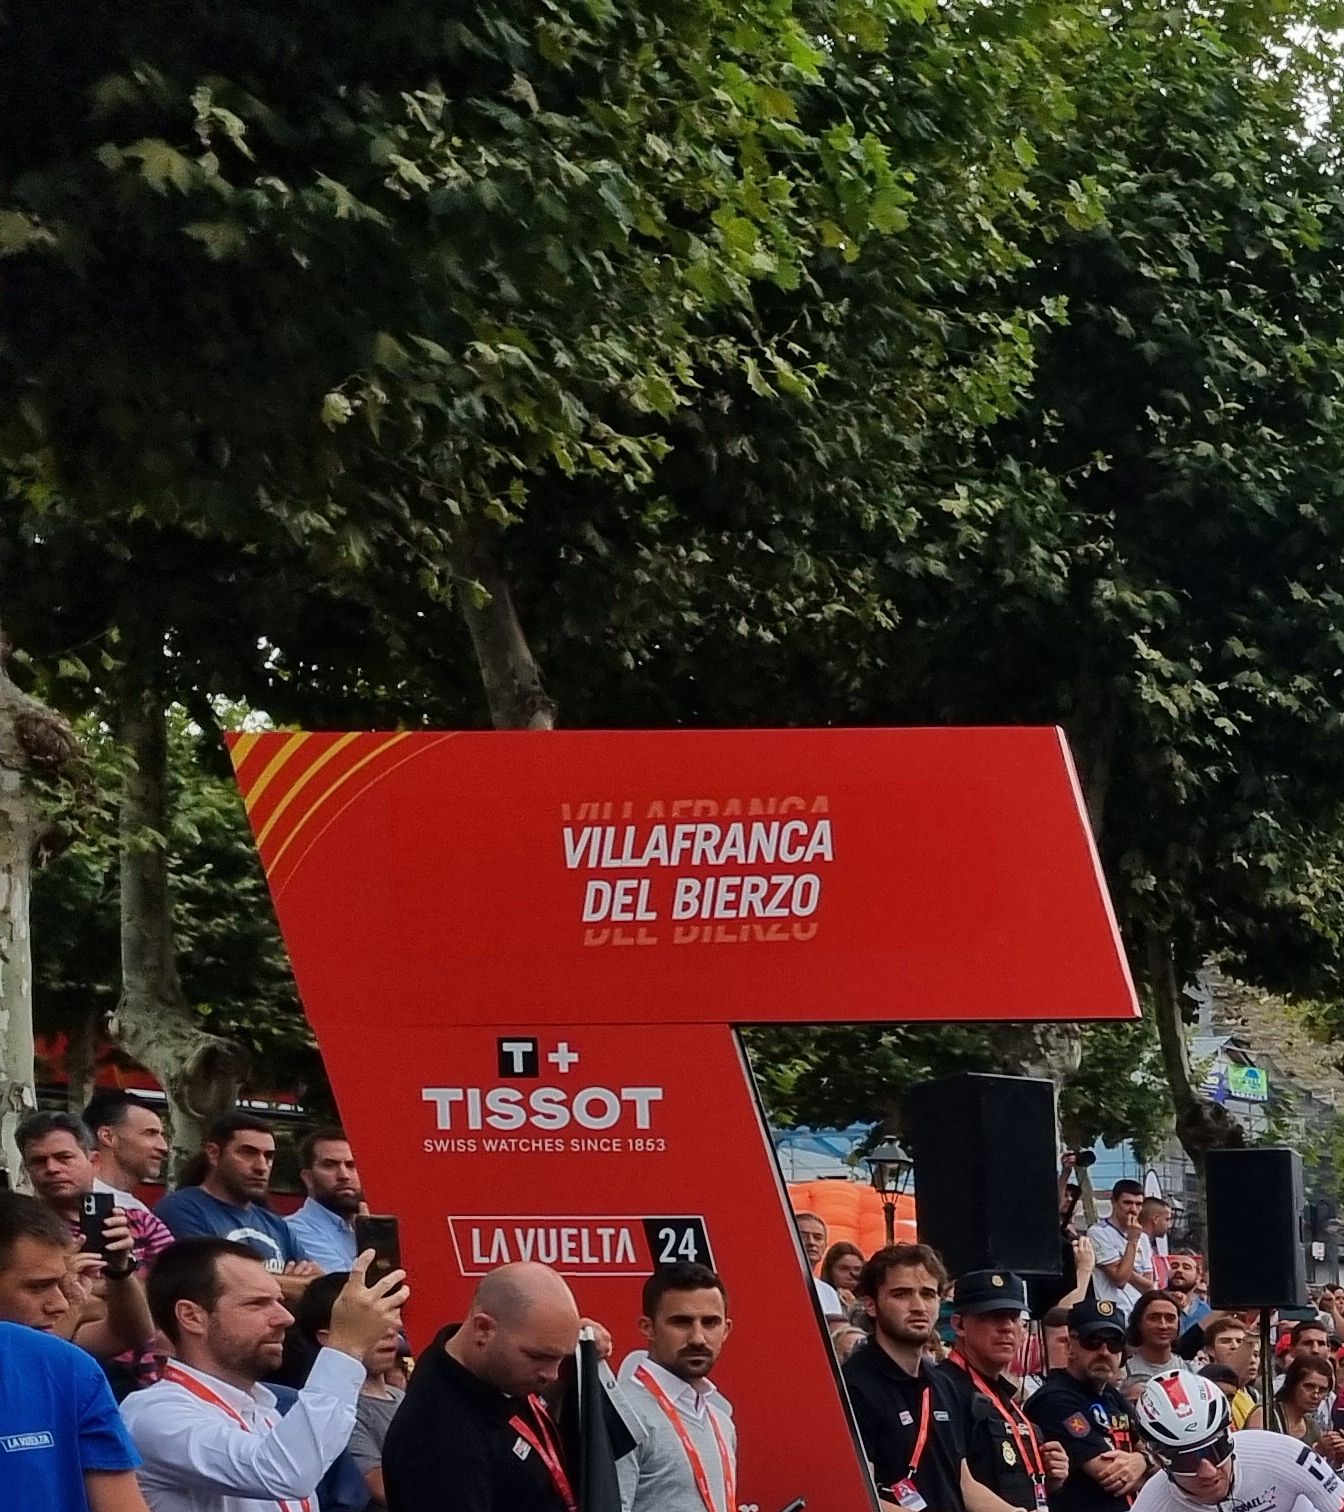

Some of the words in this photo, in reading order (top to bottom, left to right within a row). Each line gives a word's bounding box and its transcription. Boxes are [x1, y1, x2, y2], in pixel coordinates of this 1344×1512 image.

[563, 819, 834, 868] VILLAFRANCA
[582, 879, 657, 922] DEL
[672, 873, 821, 920] BIERZO
[422, 1087, 663, 1131] TISSOT
[423, 1139, 477, 1153] SWISS
[483, 1138, 565, 1153] WATCHES
[570, 1138, 622, 1153] SINCE
[627, 1137, 666, 1152] 1853
[471, 1227, 505, 1265] LA
[515, 1226, 636, 1264] VUELTA
[658, 1226, 699, 1263] 24
